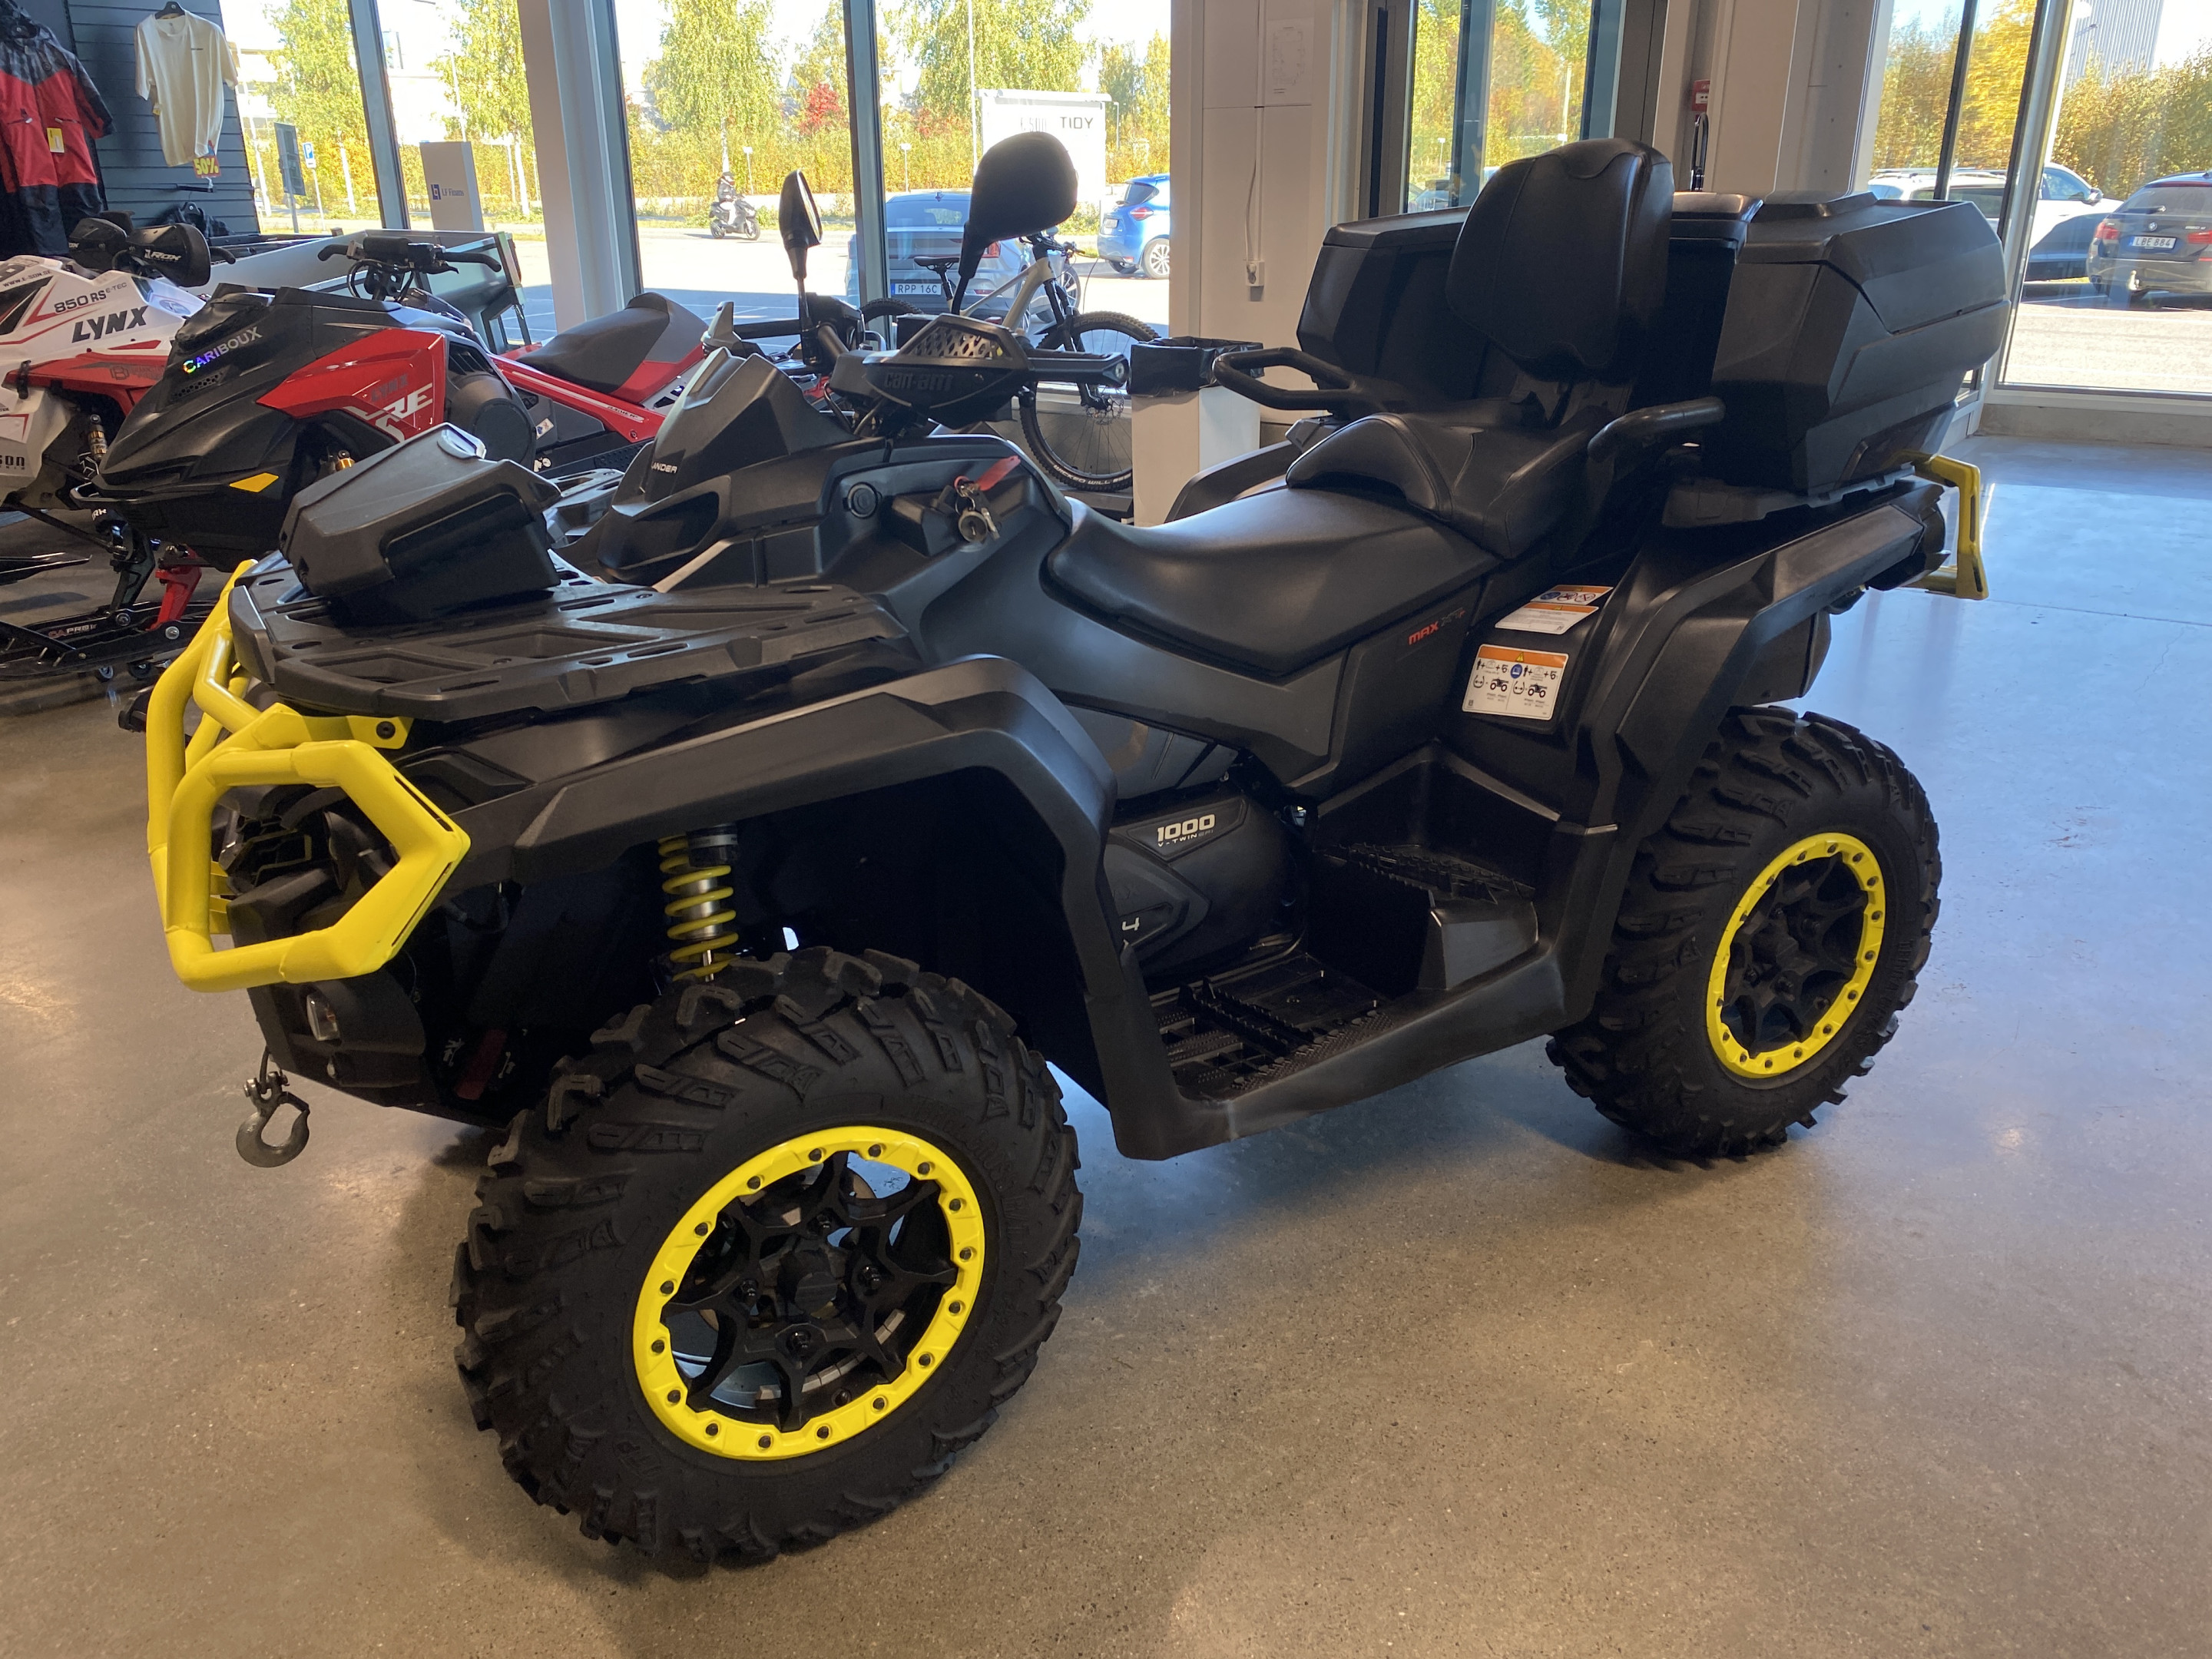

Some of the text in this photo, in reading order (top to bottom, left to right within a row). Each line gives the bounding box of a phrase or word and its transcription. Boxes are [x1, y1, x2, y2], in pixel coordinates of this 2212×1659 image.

[1060, 116, 1094, 129] TIDY
[193, 157, 220, 175] 50%
[2154, 237, 2171, 247] 884
[54, 281, 128, 313] 850 RS E-TEC
[897, 283, 939, 295] RPP 16C
[71, 305, 149, 344] LYNX
[183, 326, 263, 374] CARIBOUX
[1157, 813, 1216, 843] 1000
